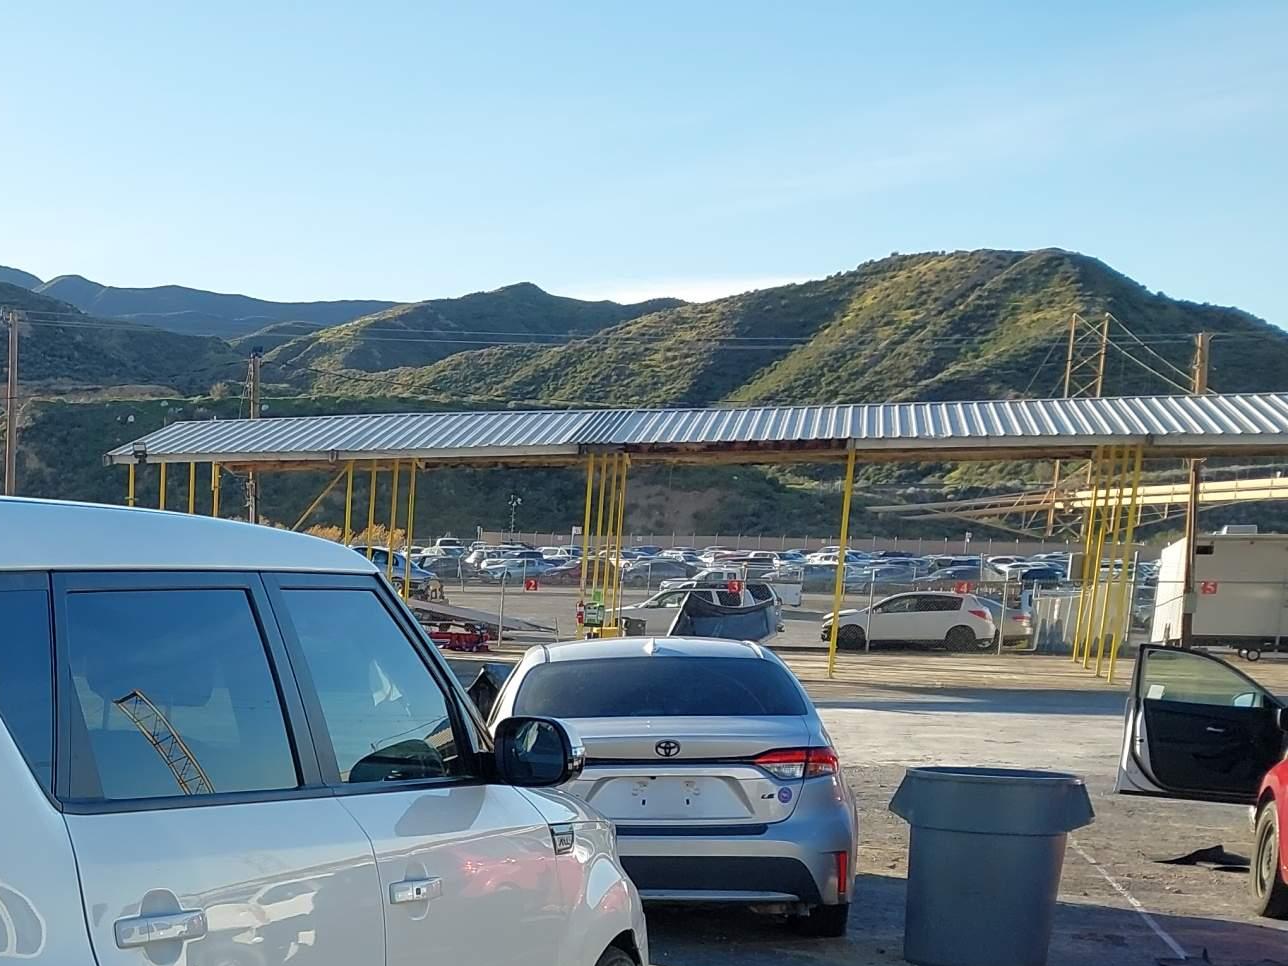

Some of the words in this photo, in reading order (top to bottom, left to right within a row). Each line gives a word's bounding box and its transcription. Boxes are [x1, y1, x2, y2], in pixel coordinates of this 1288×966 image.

[528, 579, 536, 590] 2
[732, 581, 739, 592] 3
[959, 582, 968, 593] 4
[1206, 582, 1215, 593] 5
